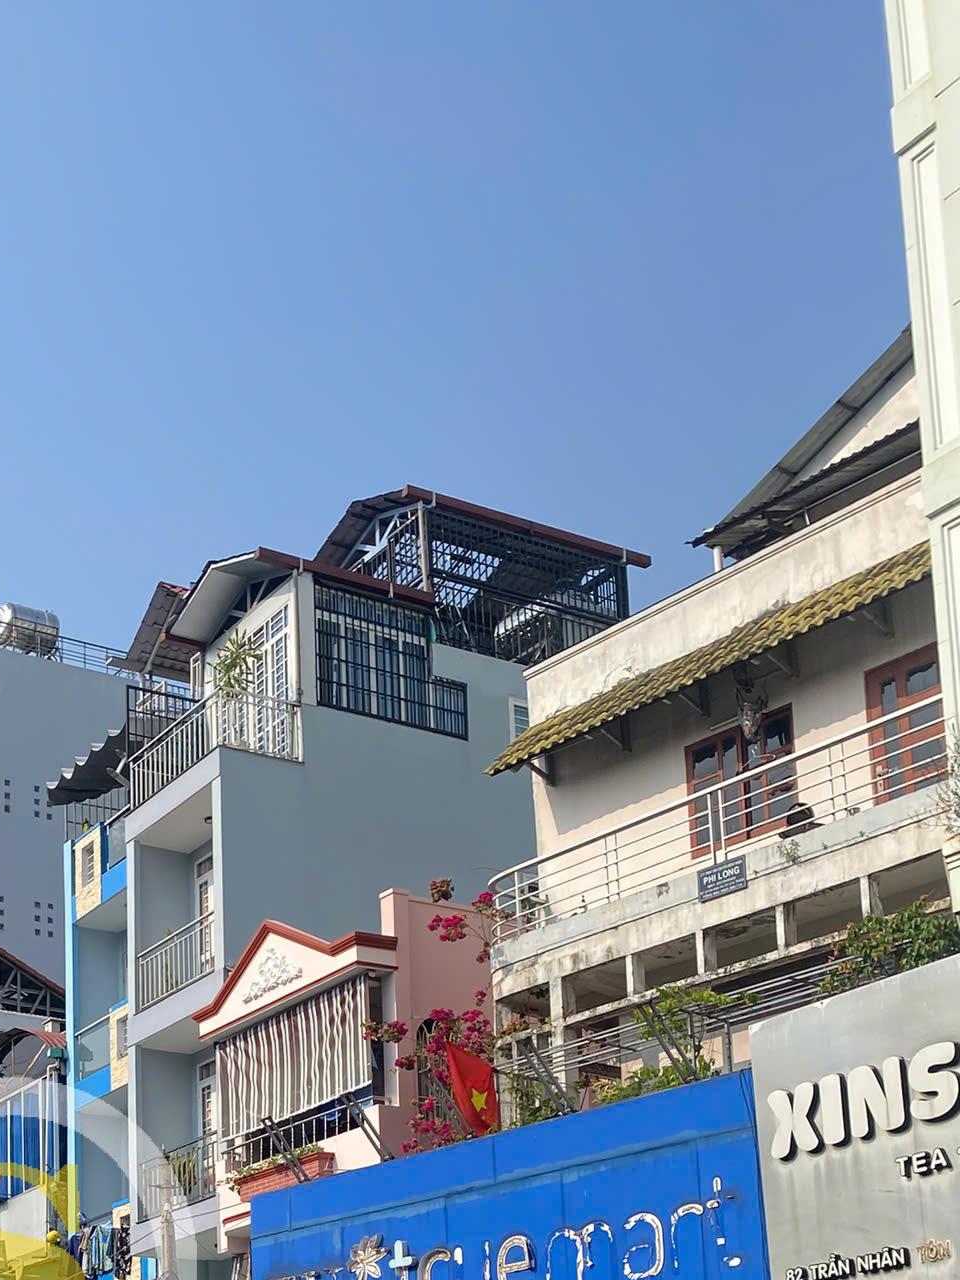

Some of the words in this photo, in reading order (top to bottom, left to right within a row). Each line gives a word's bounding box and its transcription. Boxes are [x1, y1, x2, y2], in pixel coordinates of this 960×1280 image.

[703, 873, 716, 885] PHI
[717, 866, 740, 880] LONG
[895, 1148, 948, 1177] TEA
[810, 1254, 851, 1280] TRẦN
[856, 1247, 906, 1274] NHÂN
